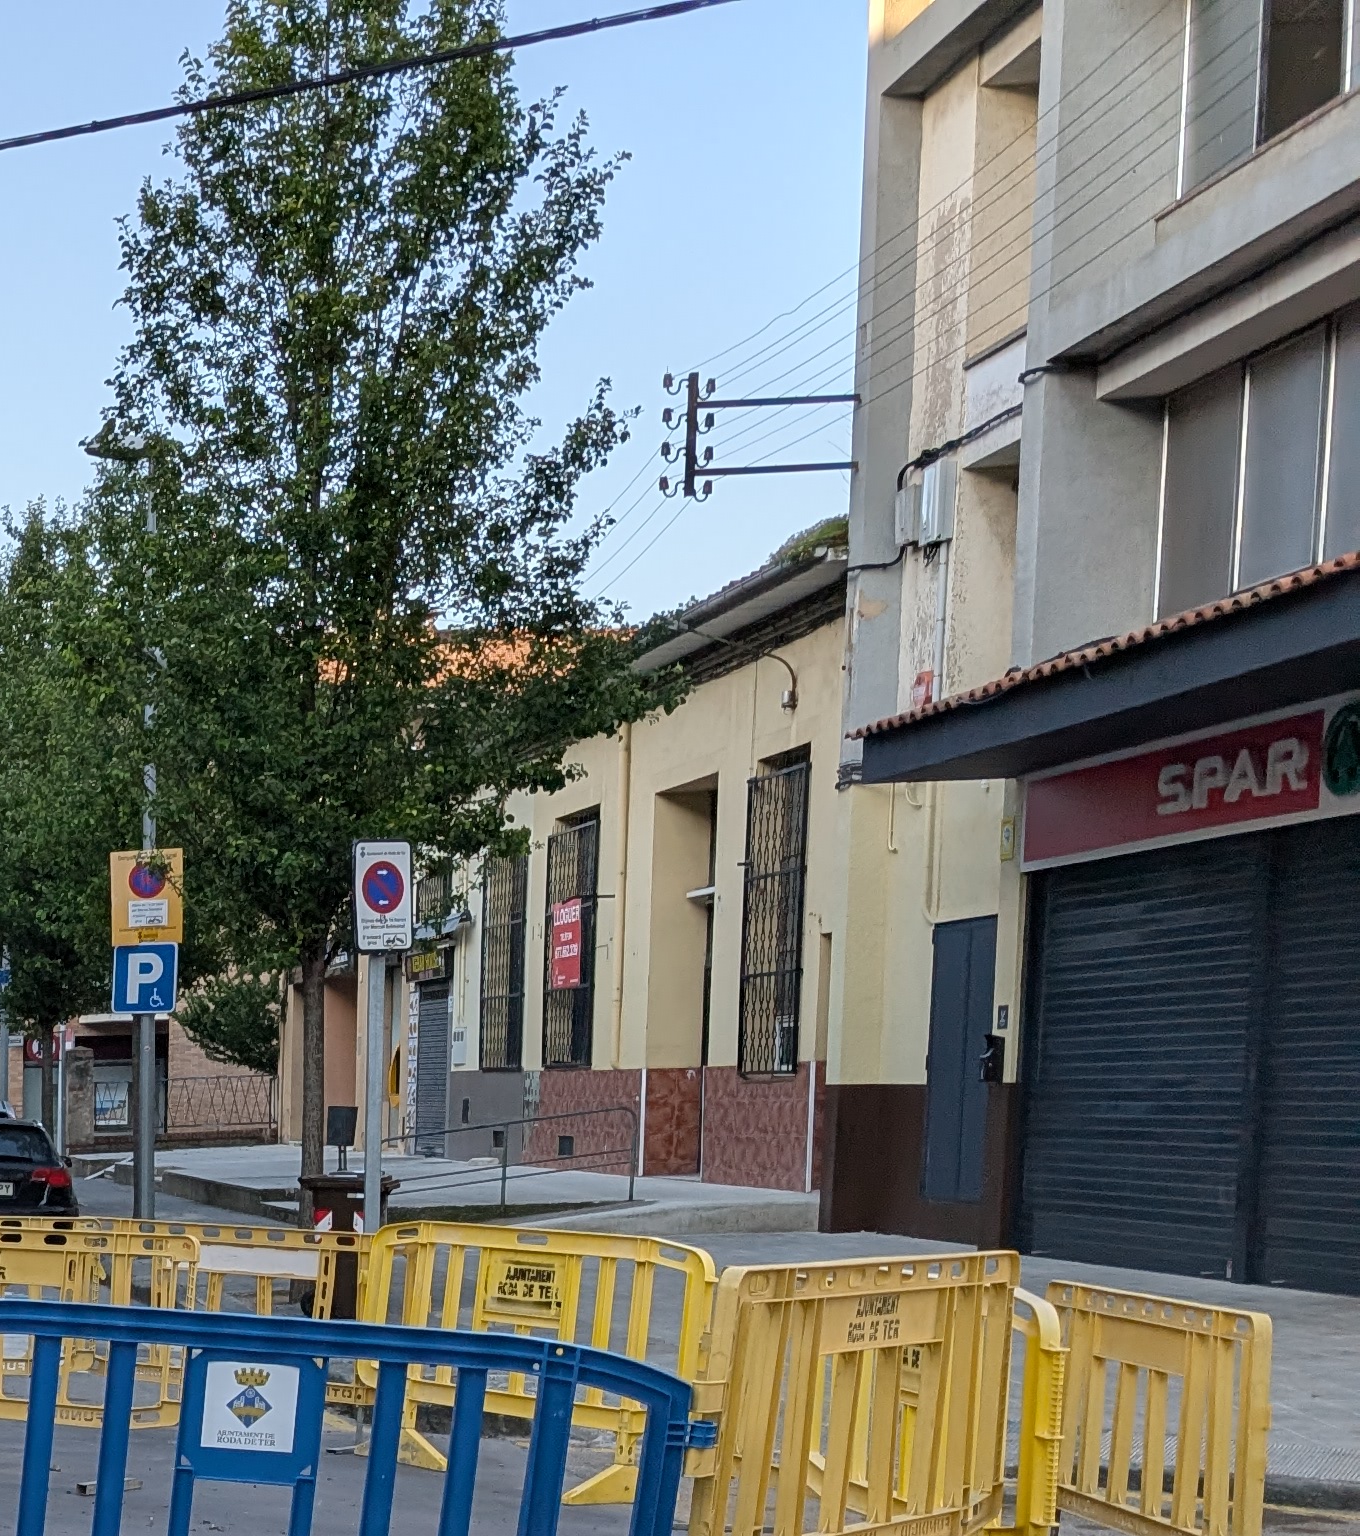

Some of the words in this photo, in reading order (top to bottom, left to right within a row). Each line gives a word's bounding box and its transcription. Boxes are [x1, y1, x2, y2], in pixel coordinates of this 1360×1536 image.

[1156, 737, 1310, 816] SPAR
[126, 952, 164, 1005] P
[505, 1265, 556, 1284] AJUNTAMENT
[522, 1283, 535, 1298] DE
[882, 1318, 900, 1341] TER
[216, 1436, 242, 1445] RODA
[243, 1437, 257, 1446] DE
[258, 1438, 276, 1447] TER
[217, 1430, 264, 1439] AJUNTAMENT
